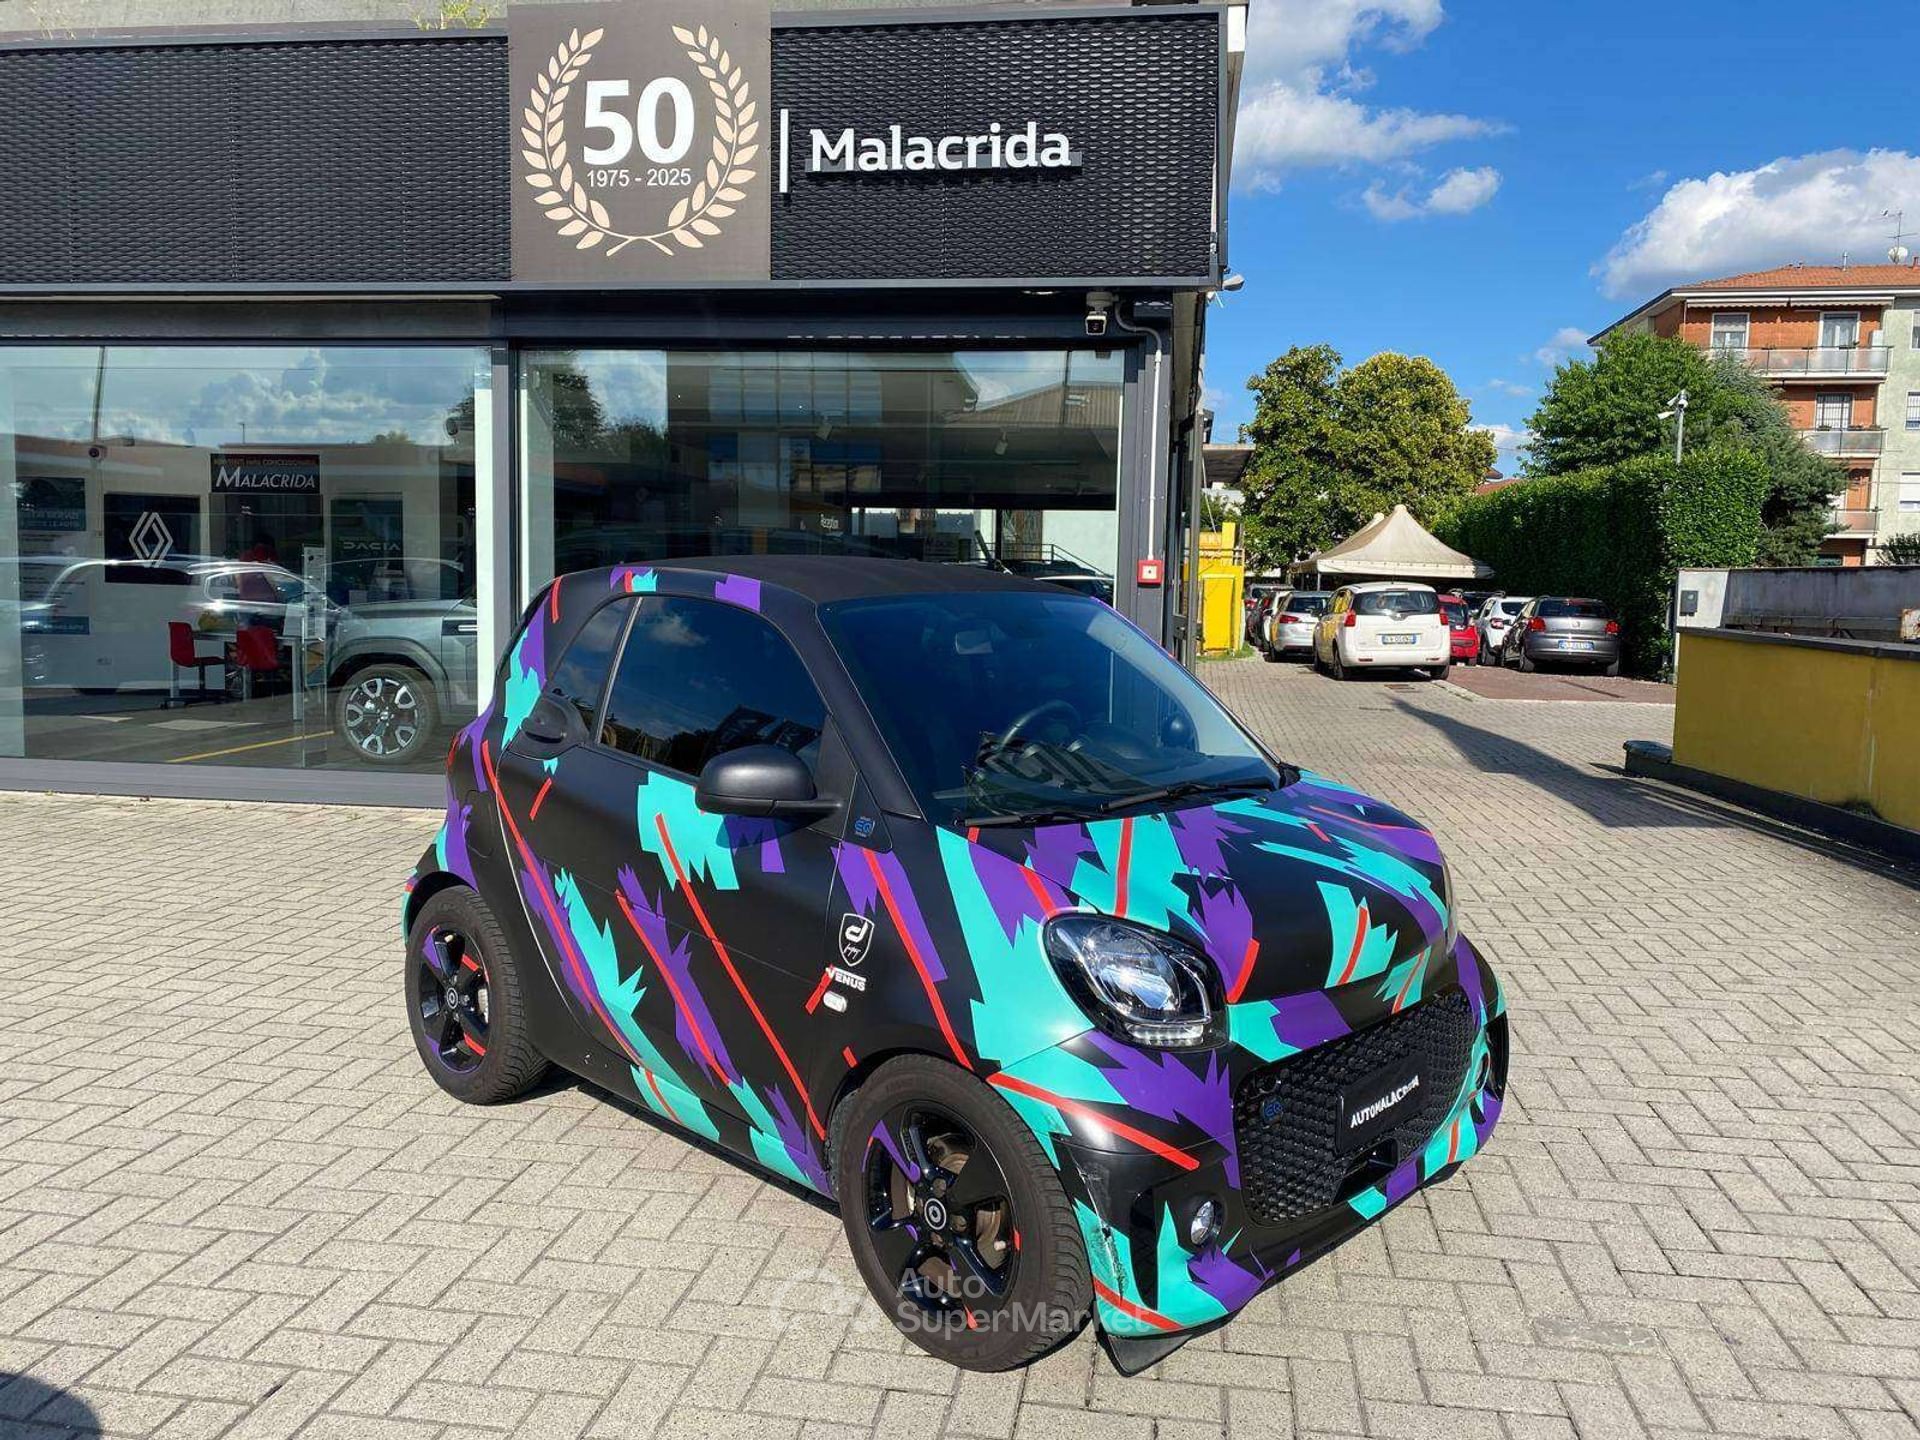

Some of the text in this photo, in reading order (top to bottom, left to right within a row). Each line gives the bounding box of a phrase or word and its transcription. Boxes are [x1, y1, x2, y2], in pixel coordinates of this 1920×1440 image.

[584, 77, 694, 165] 50
[809, 121, 1071, 171] Malacrida
[587, 169, 630, 187] 1975
[646, 167, 692, 186] 2025
[825, 966, 867, 992] VENUS
